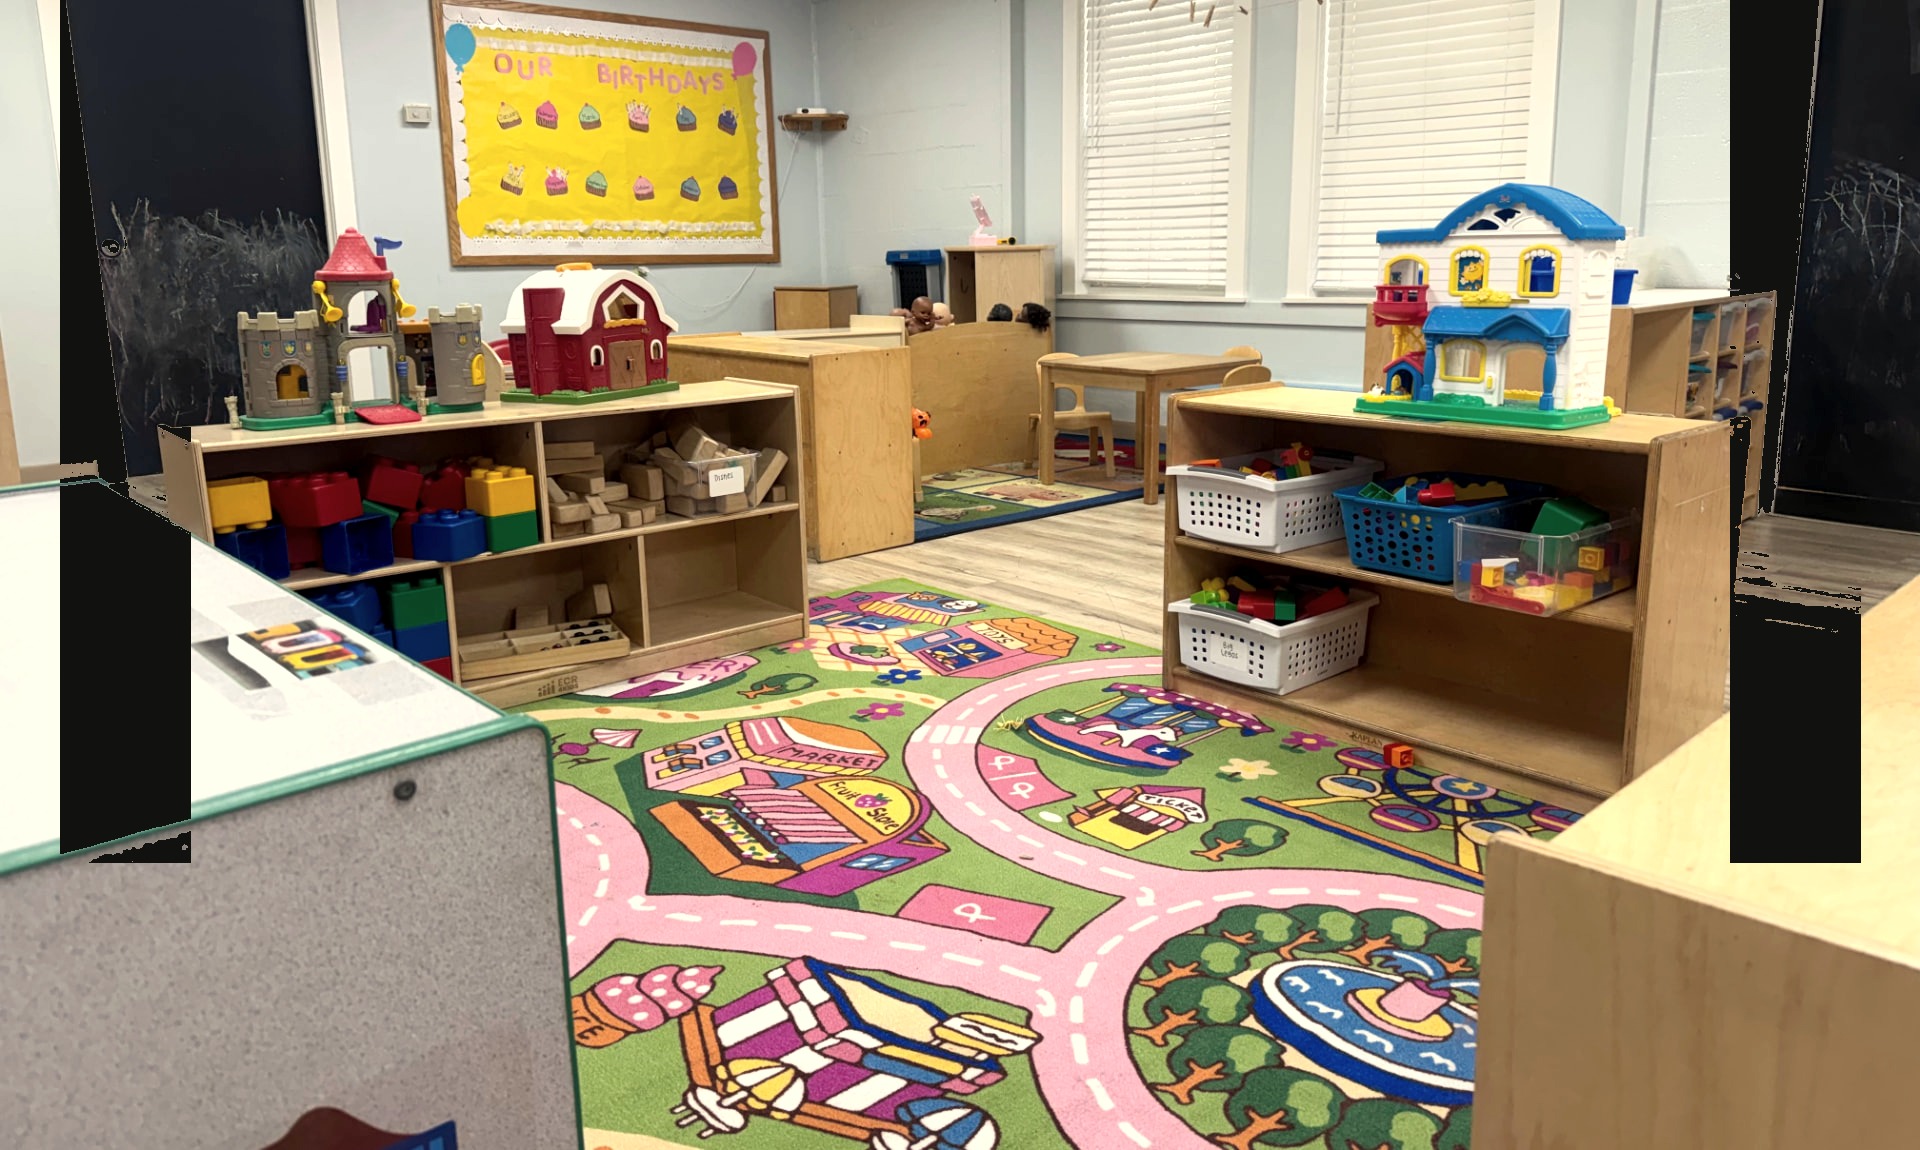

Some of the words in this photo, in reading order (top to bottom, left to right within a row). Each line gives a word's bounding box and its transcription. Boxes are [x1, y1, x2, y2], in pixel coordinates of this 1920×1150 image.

[494, 53, 553, 80] OUR
[597, 63, 725, 95] BIRTHDAYS
[976, 627, 1014, 644] TOYS
[777, 746, 879, 767] MARKET
[829, 781, 862, 801] Fruit
[866, 807, 900, 831] Store
